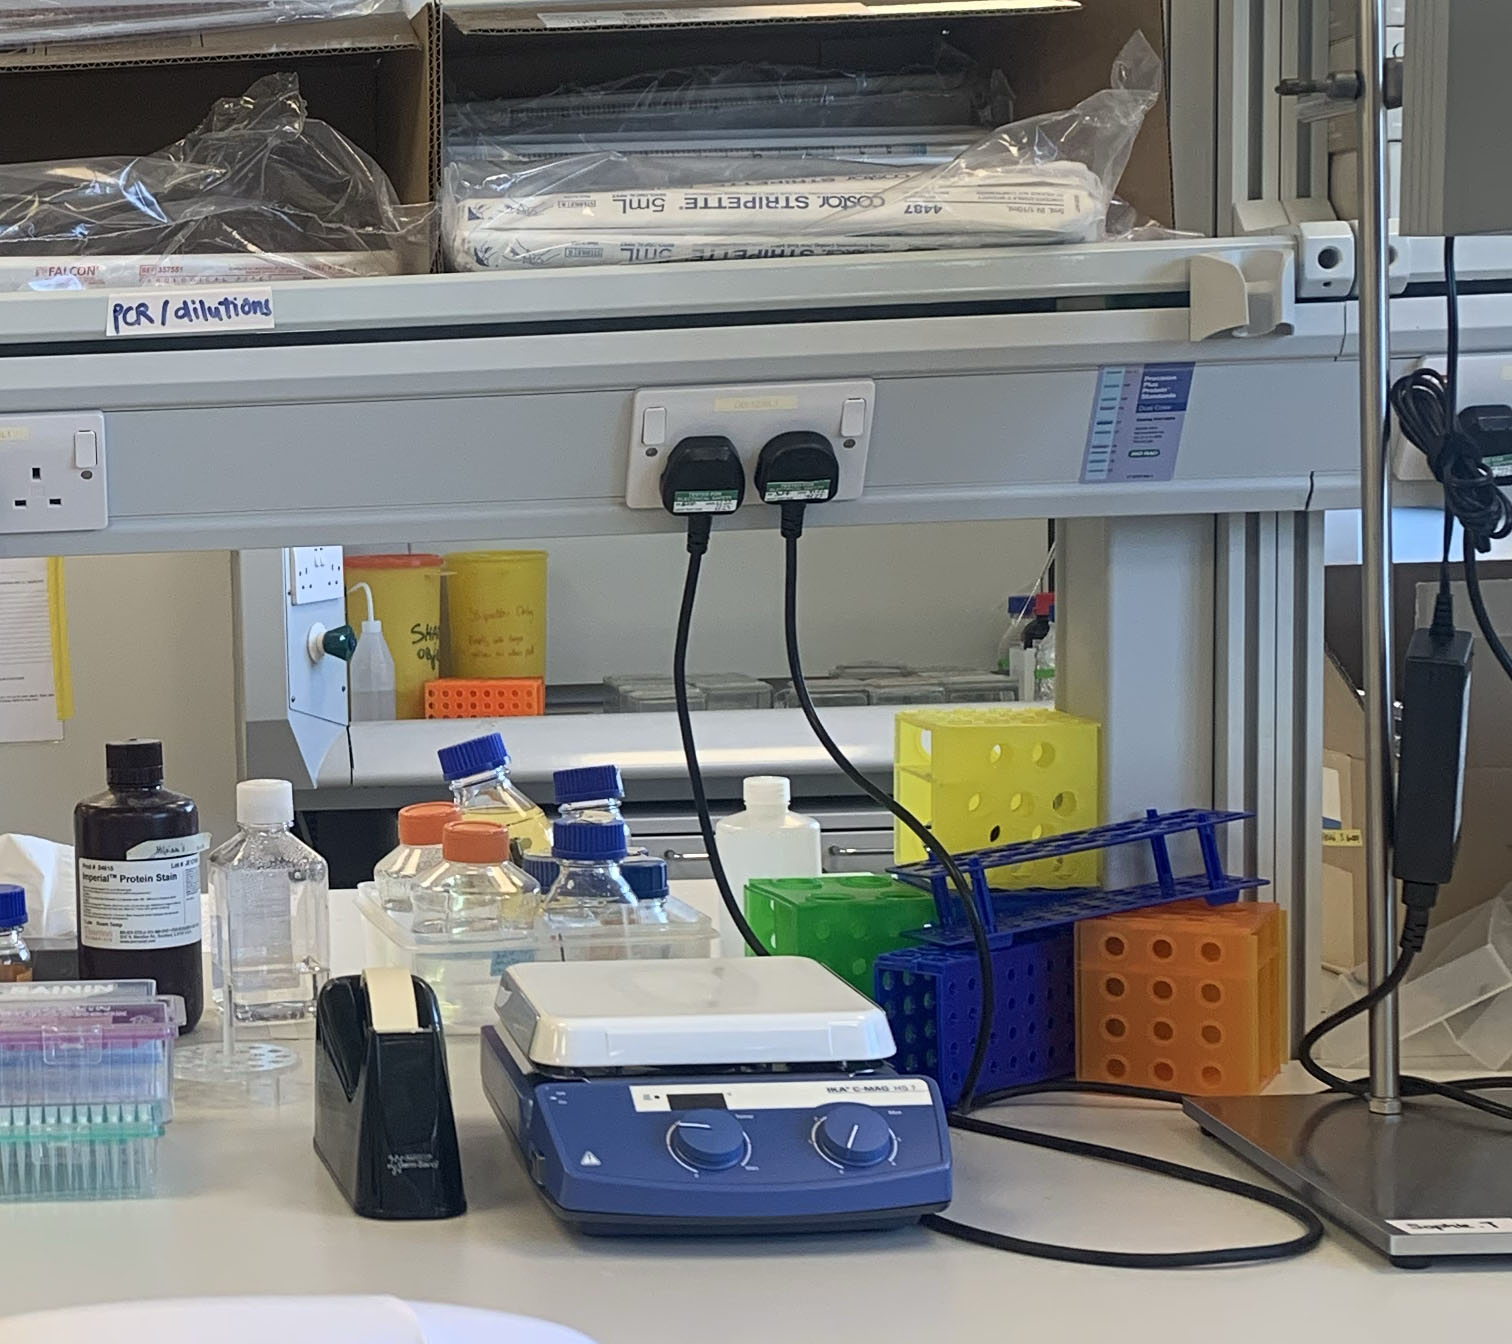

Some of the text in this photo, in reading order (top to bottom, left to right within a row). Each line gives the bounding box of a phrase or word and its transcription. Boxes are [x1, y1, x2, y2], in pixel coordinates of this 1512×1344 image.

[611, 197, 665, 214] 5mL
[904, 203, 943, 215] 4487
[112, 299, 155, 334] PCR
[174, 297, 272, 323] dilutions
[119, 873, 154, 883] Protein
[155, 872, 178, 882] Stain
